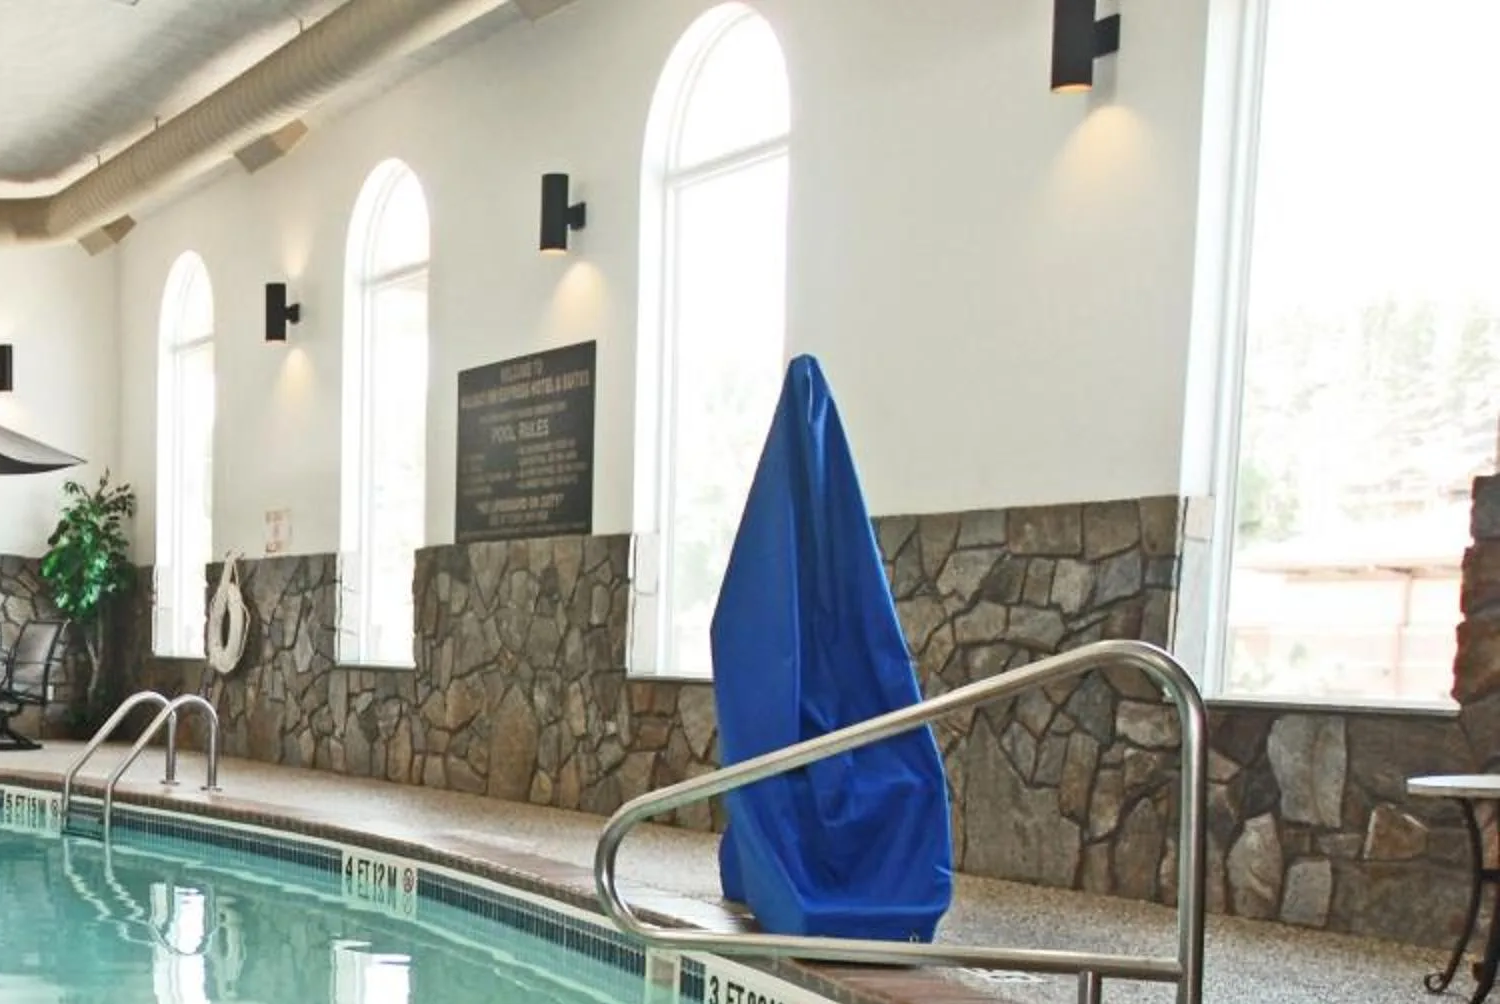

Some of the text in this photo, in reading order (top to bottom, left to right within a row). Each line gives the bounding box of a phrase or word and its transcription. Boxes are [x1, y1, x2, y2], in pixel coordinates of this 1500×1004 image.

[519, 418, 548, 438] RULES
[345, 856, 352, 876] 4
[358, 859, 370, 882] FT
